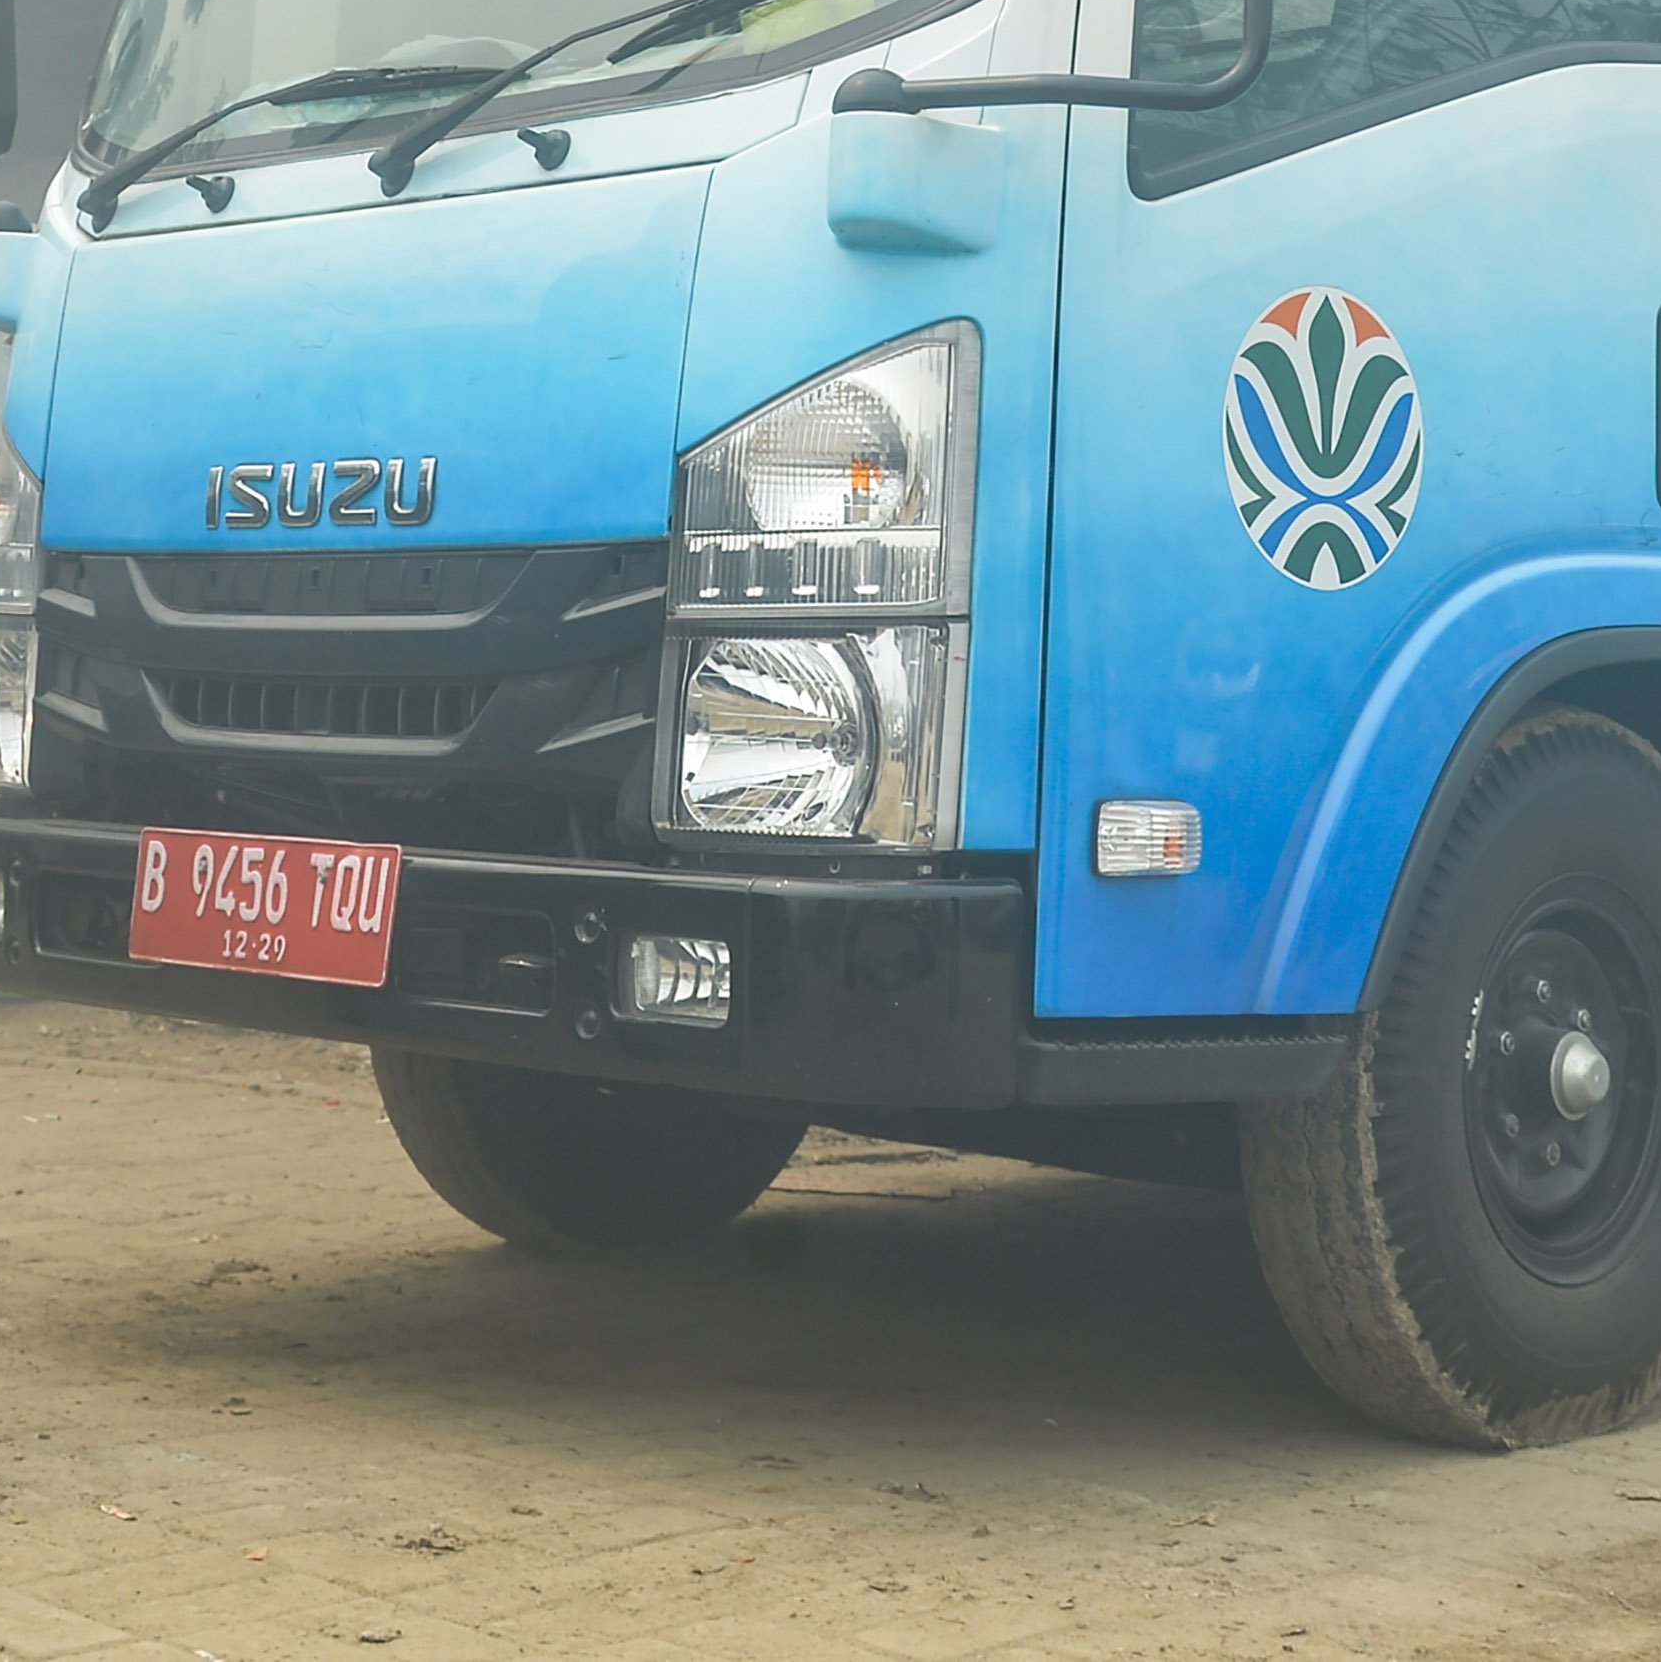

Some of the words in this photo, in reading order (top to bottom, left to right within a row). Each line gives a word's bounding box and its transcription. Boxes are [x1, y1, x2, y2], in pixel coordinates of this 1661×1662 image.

[205, 456, 438, 530] ISUZU
[141, 840, 167, 912] B
[192, 843, 288, 925] 9456
[310, 852, 390, 933] TQU
